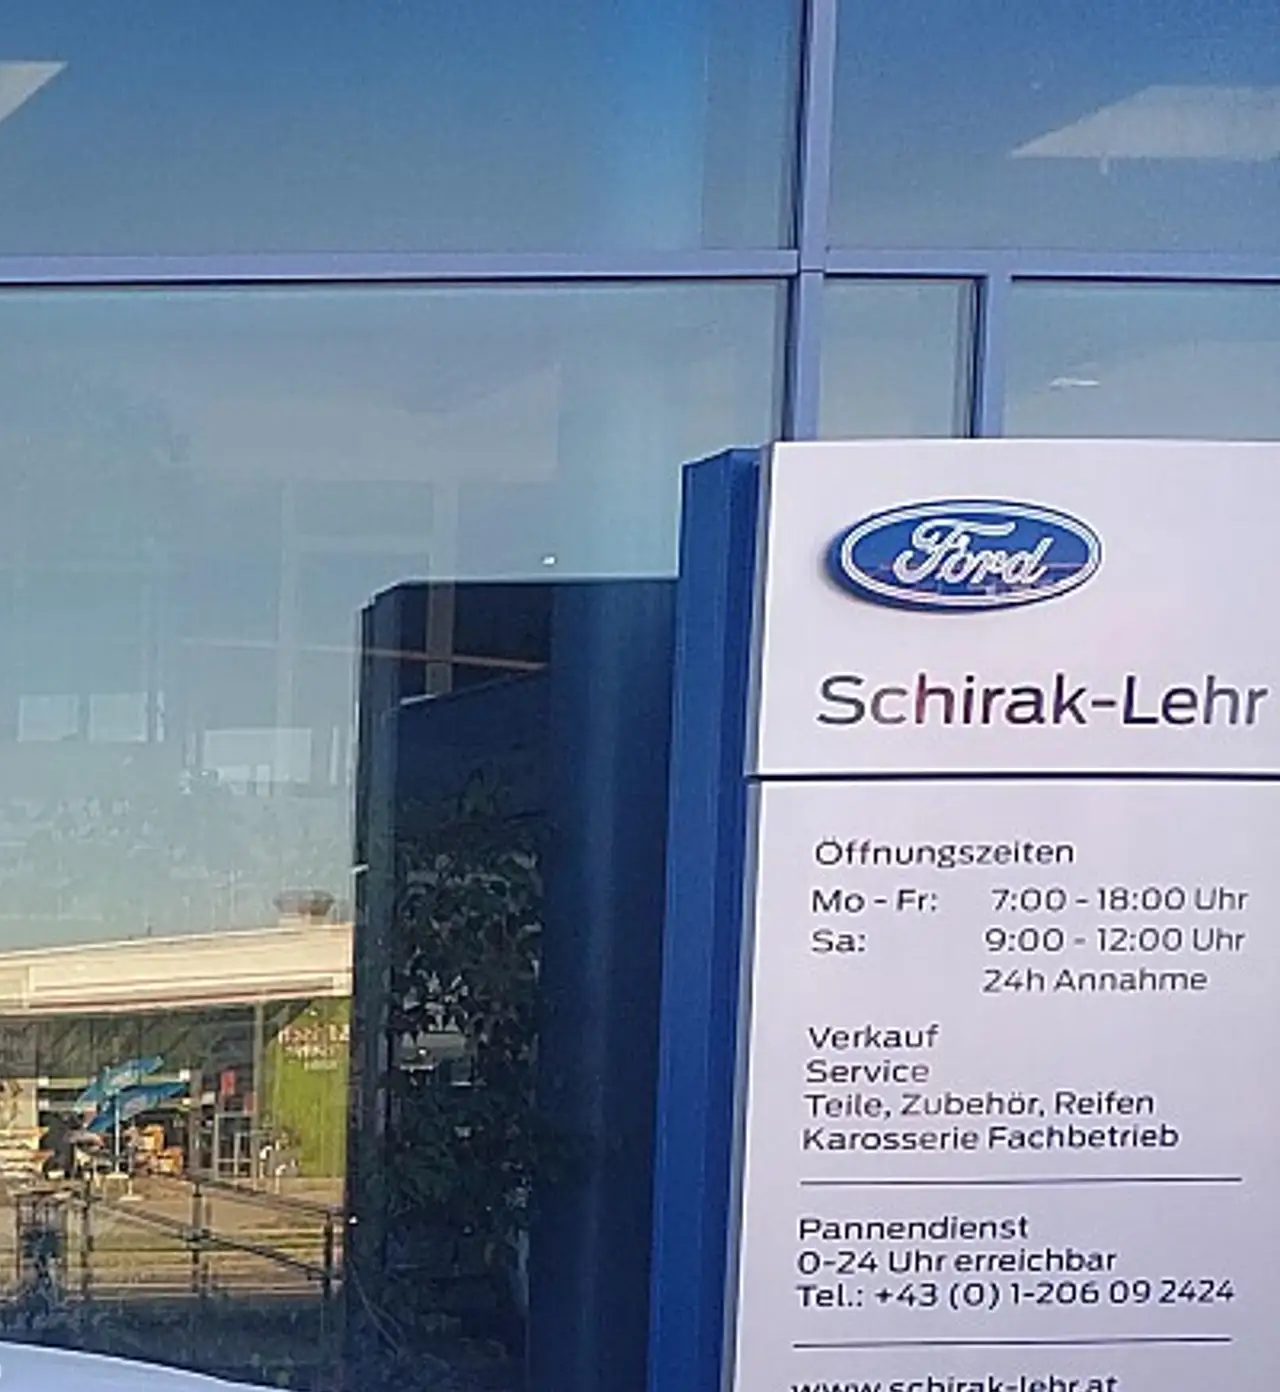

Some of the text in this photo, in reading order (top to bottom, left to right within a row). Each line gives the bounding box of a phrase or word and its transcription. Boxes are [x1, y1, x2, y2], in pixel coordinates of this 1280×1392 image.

[893, 518, 1054, 586] Ford
[815, 672, 1269, 726] Schirak-Lehr
[815, 835, 1074, 870] Öffnungszeiten
[812, 888, 866, 914] Mo
[896, 888, 938, 913] Fr:
[991, 887, 1067, 913] 7:00
[1097, 886, 1186, 912] 18:00
[1194, 886, 1250, 911] Uhr
[811, 928, 866, 954] Sa:
[985, 927, 1064, 953] 9:00
[1097, 927, 1183, 952] 12:00
[1192, 927, 1246, 952] Uhr
[982, 966, 1208, 994] 24h Annahme
[807, 1023, 940, 1051] Verkauf
[805, 1058, 930, 1084] Service
[803, 1090, 1154, 1121] Teile, Zubehör, Reifen
[802, 1122, 1180, 1151] Karosserie Fachbetrieb
[799, 1215, 1029, 1241] Pannendienst
[797, 1247, 1118, 1276] 0-24 Uhr erreichbar
[794, 1279, 1235, 1311] Tel.: +43 (0) 1-206 09 2424
